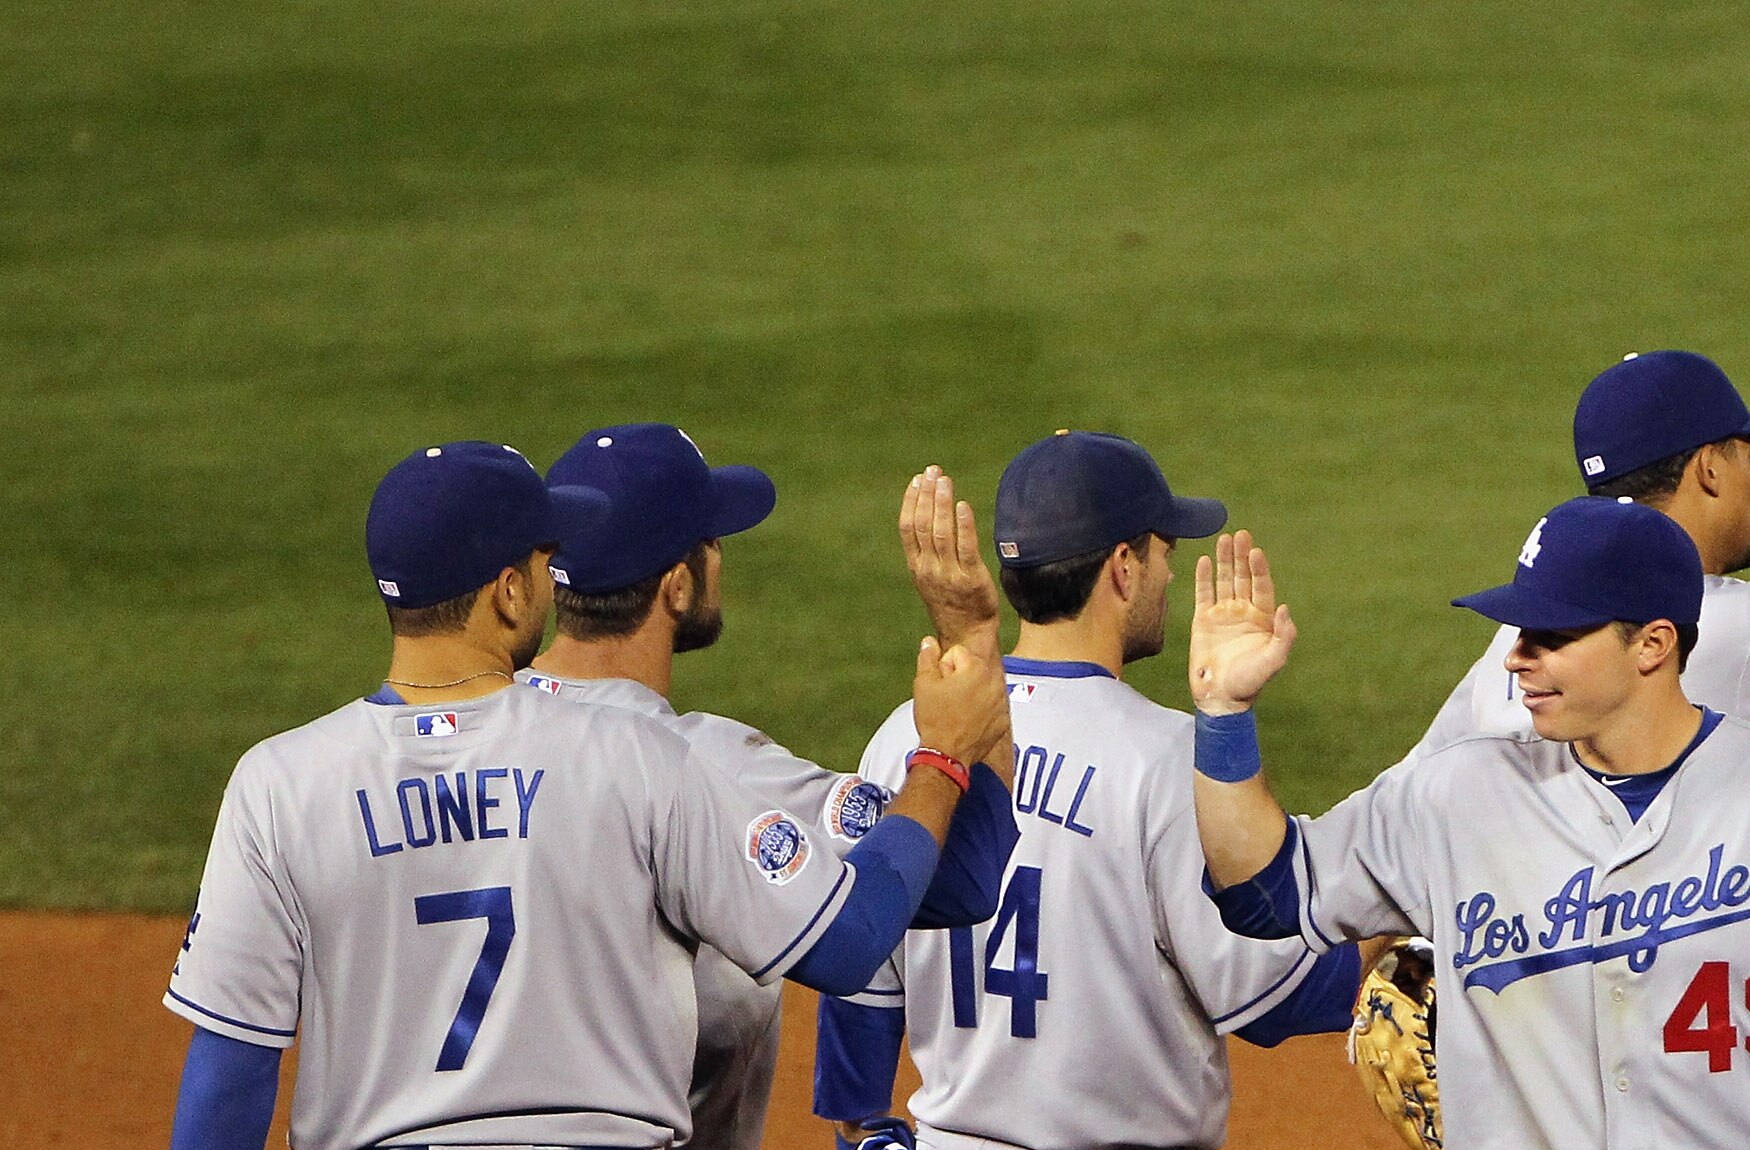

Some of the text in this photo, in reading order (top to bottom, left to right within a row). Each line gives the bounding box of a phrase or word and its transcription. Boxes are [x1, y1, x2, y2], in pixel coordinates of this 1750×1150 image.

[1517, 517, 1548, 569] LA
[357, 768, 545, 857] LONEY
[841, 791, 867, 822] 1955
[1013, 743, 1096, 838] OLL
[949, 865, 1048, 1039] 14
[1453, 891, 1530, 968] Los
[414, 886, 516, 1072] 7
